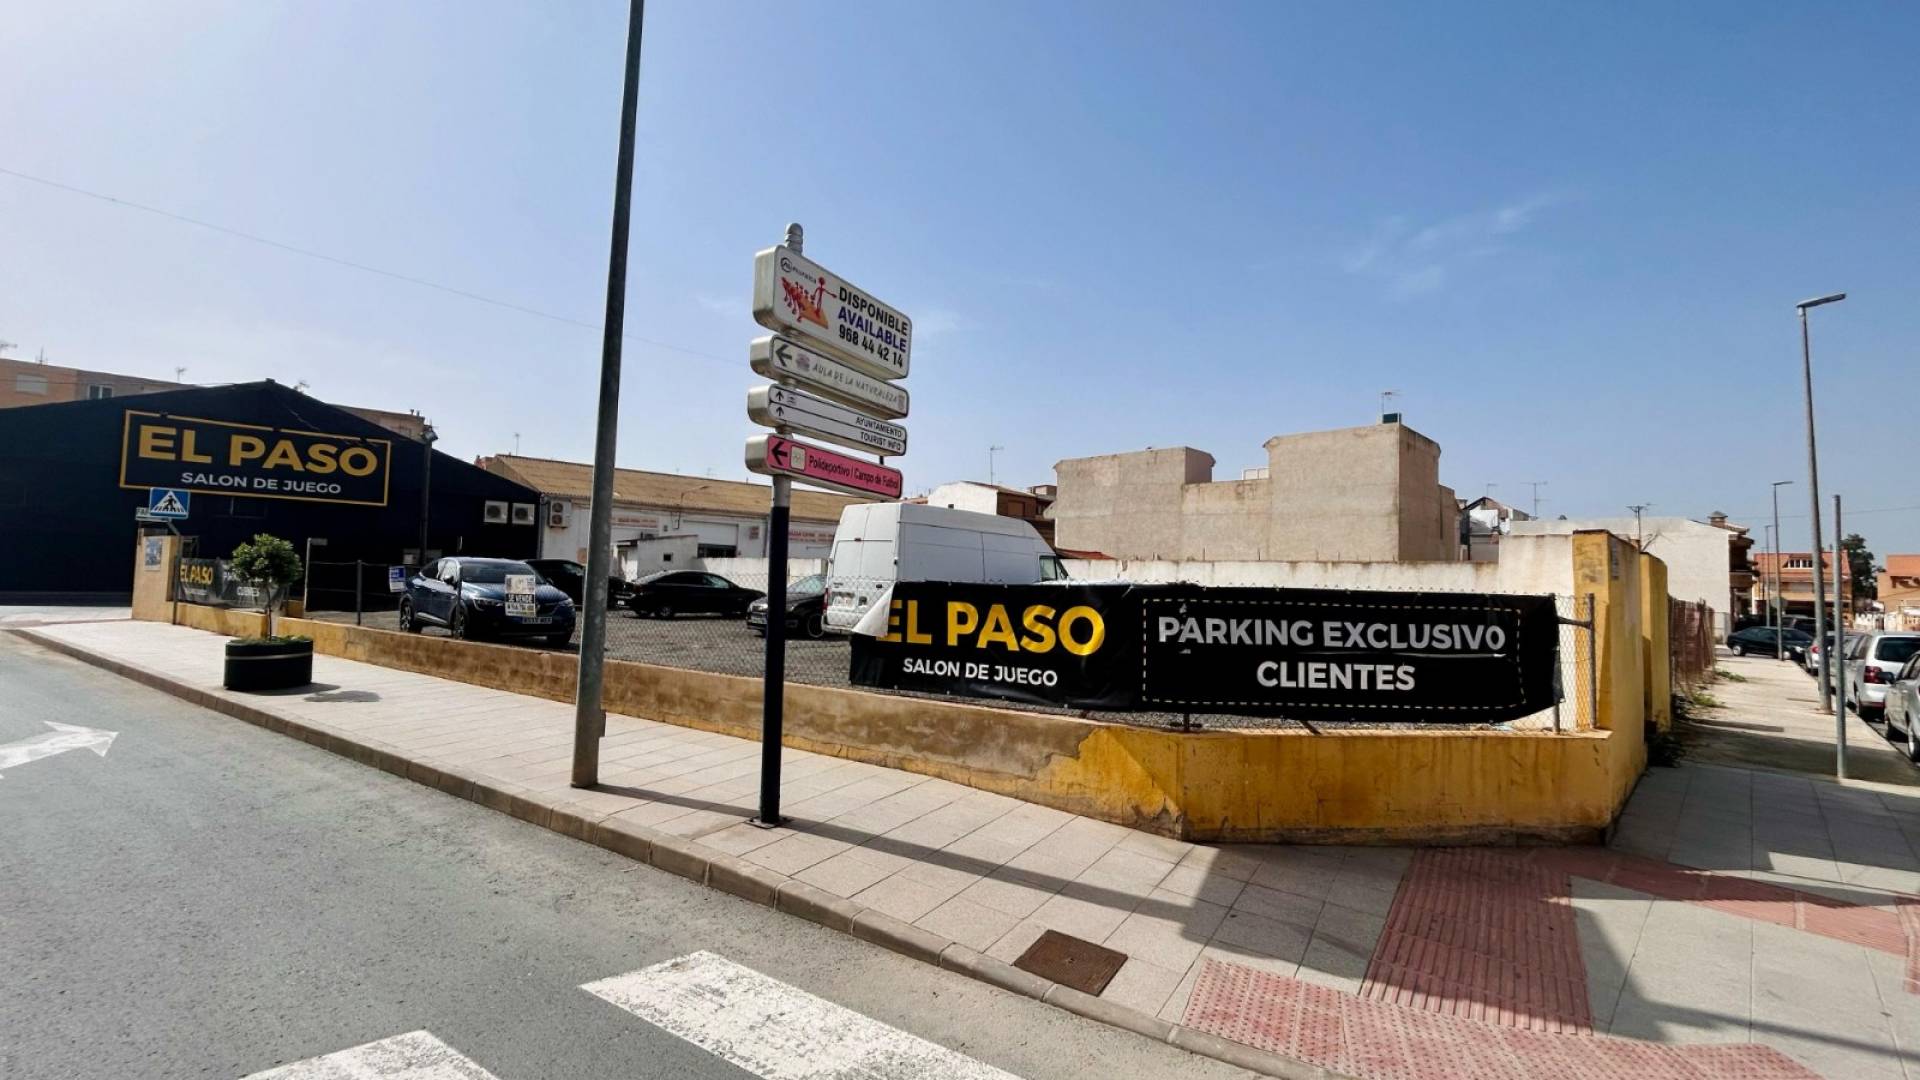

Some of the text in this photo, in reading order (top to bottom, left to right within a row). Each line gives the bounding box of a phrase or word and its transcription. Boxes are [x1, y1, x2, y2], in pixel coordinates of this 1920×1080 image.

[839, 286, 908, 336] DISPONIBLE
[838, 306, 907, 353] AVAILABLE
[839, 324, 903, 368] 968 44 42 14
[812, 363, 898, 404] AULA DE LA NATURALEZA
[855, 416, 902, 438] AYUNTAMIENTO
[860, 431, 901, 451] TOURIST INFO
[138, 424, 378, 477] EL PASO
[180, 471, 342, 494] SALON DE JUEGO
[808, 455, 851, 477] Polideportivo
[854, 467, 874, 485] Campo
[874, 475, 882, 484] de
[190, 565, 213, 585] PASO
[875, 600, 1105, 656] EL PASO
[1158, 616, 1506, 651] PARKING EXCLUSIVO
[902, 658, 1058, 686] SALON DE JUEGO
[1256, 660, 1416, 691] CLIENTES
